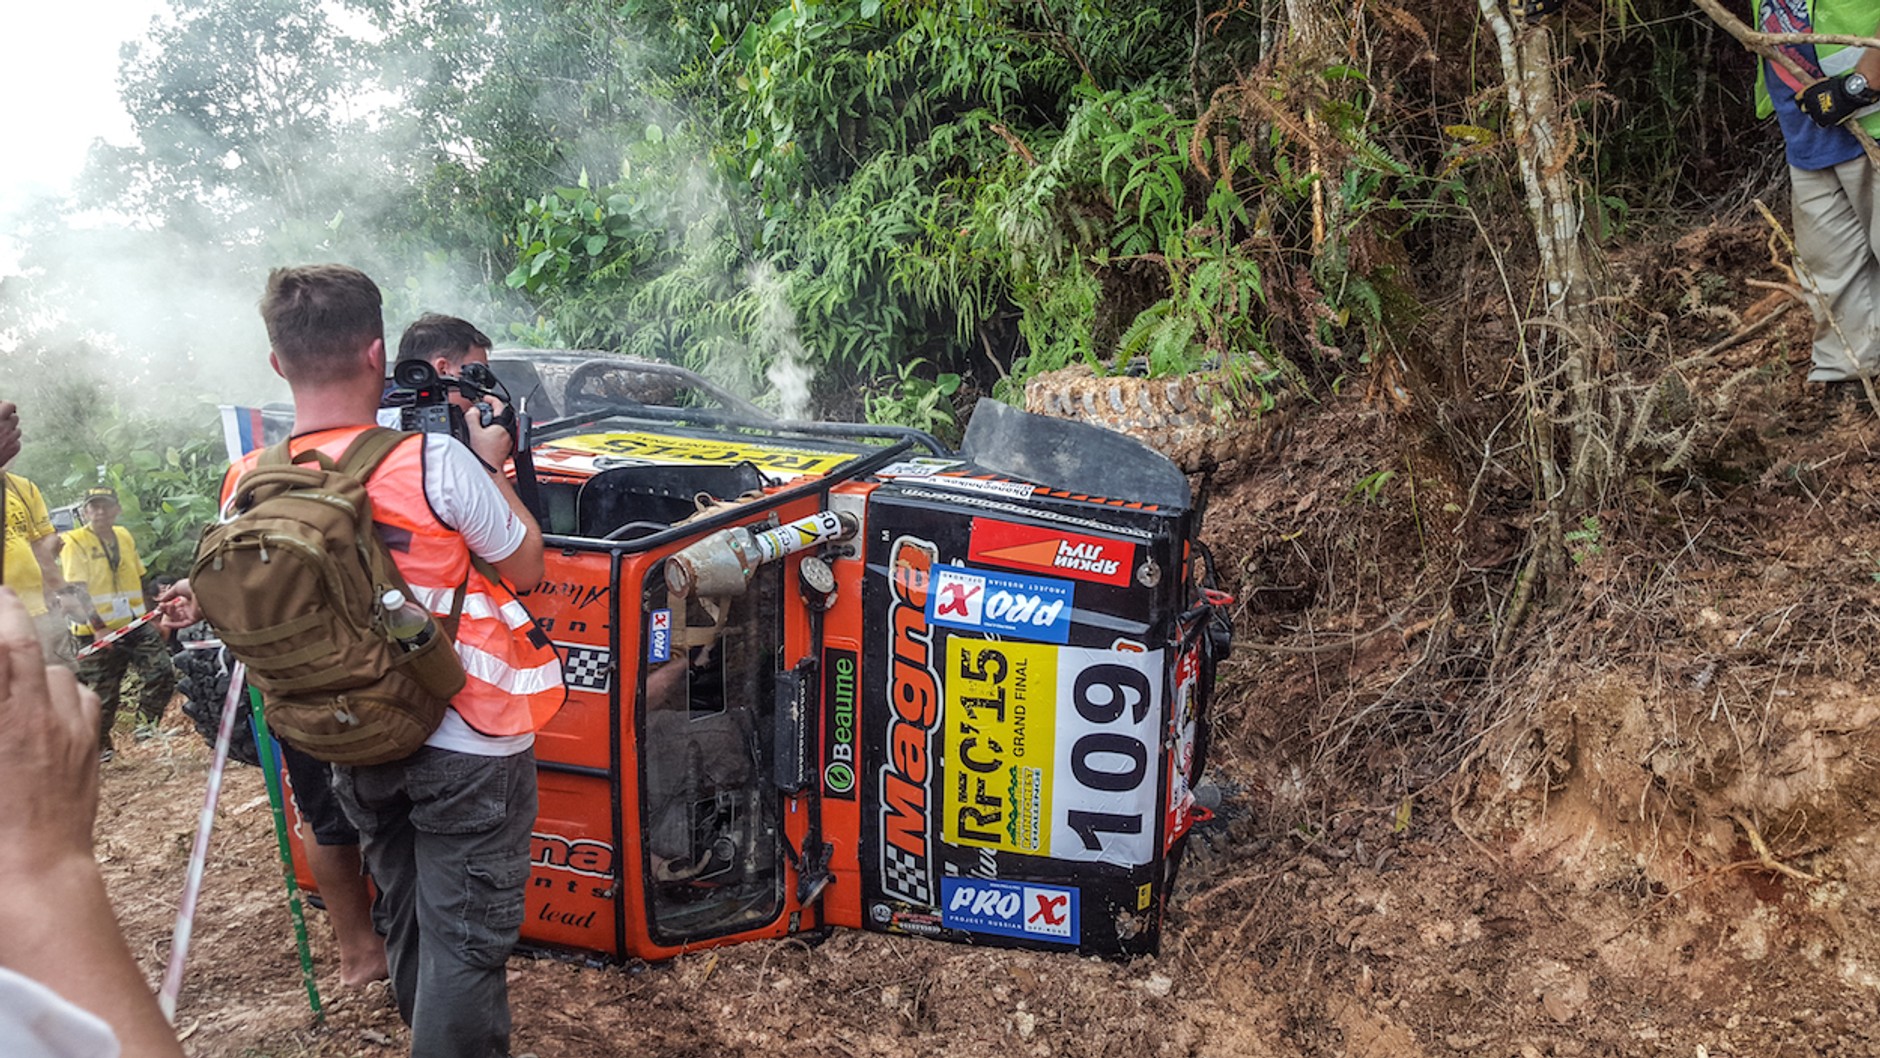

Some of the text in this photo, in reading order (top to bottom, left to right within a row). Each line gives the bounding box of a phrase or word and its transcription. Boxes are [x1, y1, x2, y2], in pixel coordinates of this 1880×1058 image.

[1058, 540, 1103, 560] ЛУЧ
[937, 582, 1064, 627] PRO X
[988, 580, 1066, 594] PROJECT RUSSIAN
[654, 613, 666, 658] PRO X
[833, 658, 854, 762] Beaume
[884, 540, 941, 858] Magna
[1013, 658, 1028, 757] GRAND FINAL
[957, 648, 1007, 844] RFC'15
[1068, 663, 1151, 851] 109
[1021, 768, 1033, 849] RAINFOREST
[1032, 769, 1042, 850] CHALLENGE
[539, 902, 596, 929] lead
[949, 886, 1067, 925] PRO X
[949, 915, 984, 925] PROJECT
[988, 919, 1023, 930] RUSSIAN
